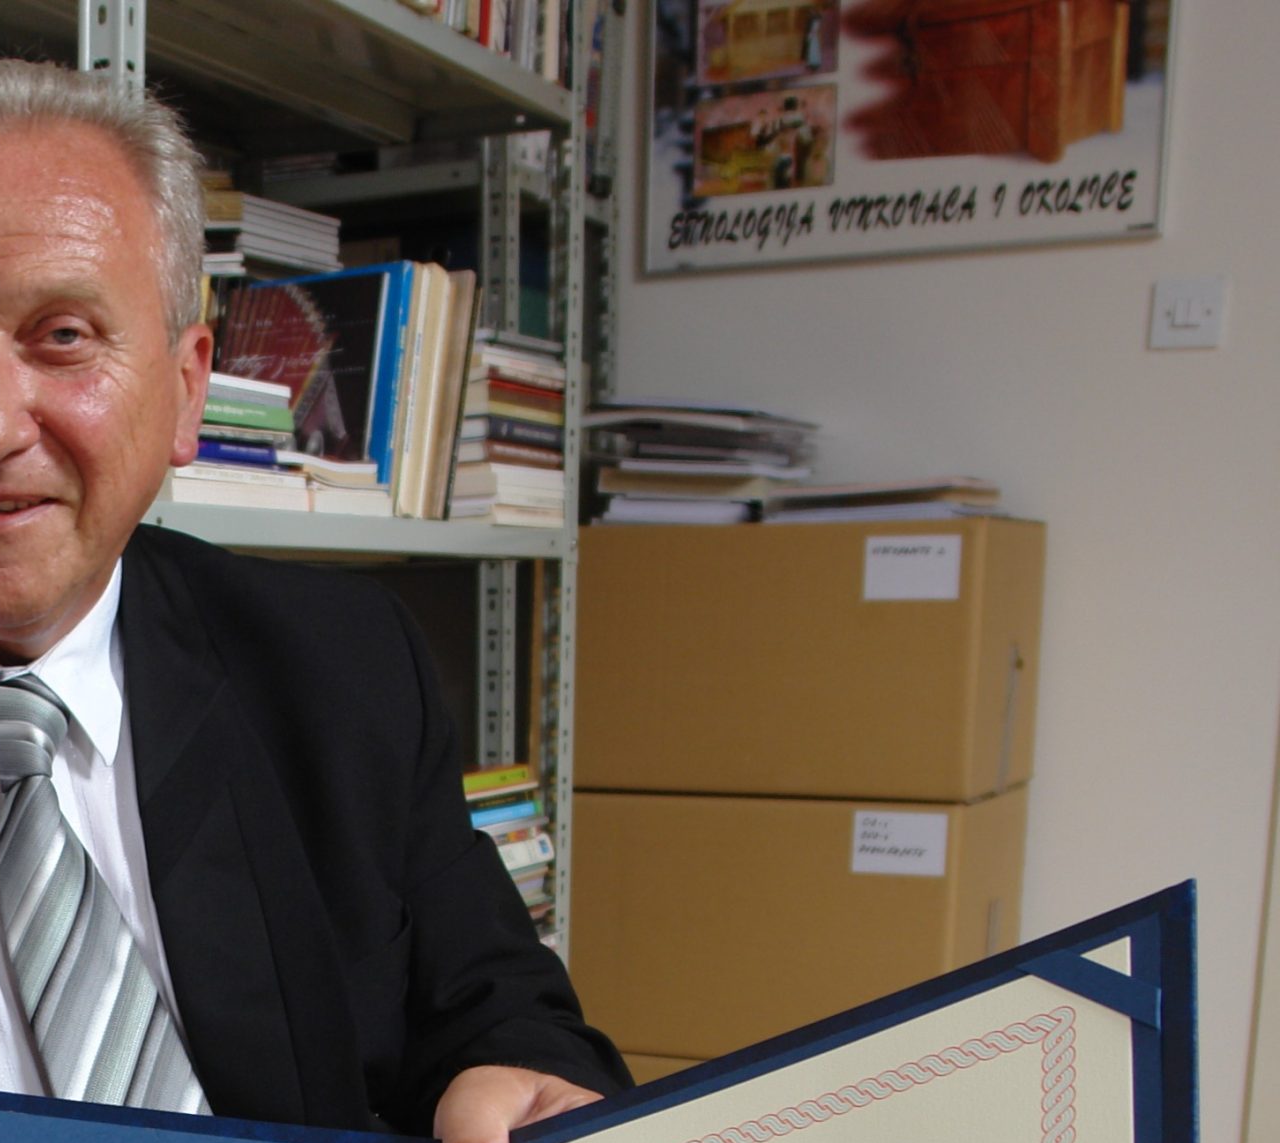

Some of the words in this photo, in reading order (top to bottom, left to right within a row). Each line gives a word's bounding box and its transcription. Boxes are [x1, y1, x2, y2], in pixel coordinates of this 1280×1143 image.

[669, 204, 814, 251] ETNOLOGIJA
[828, 185, 978, 233] VINKOVACA
[993, 183, 1007, 218] I
[1019, 169, 1138, 216] OKOLICE
